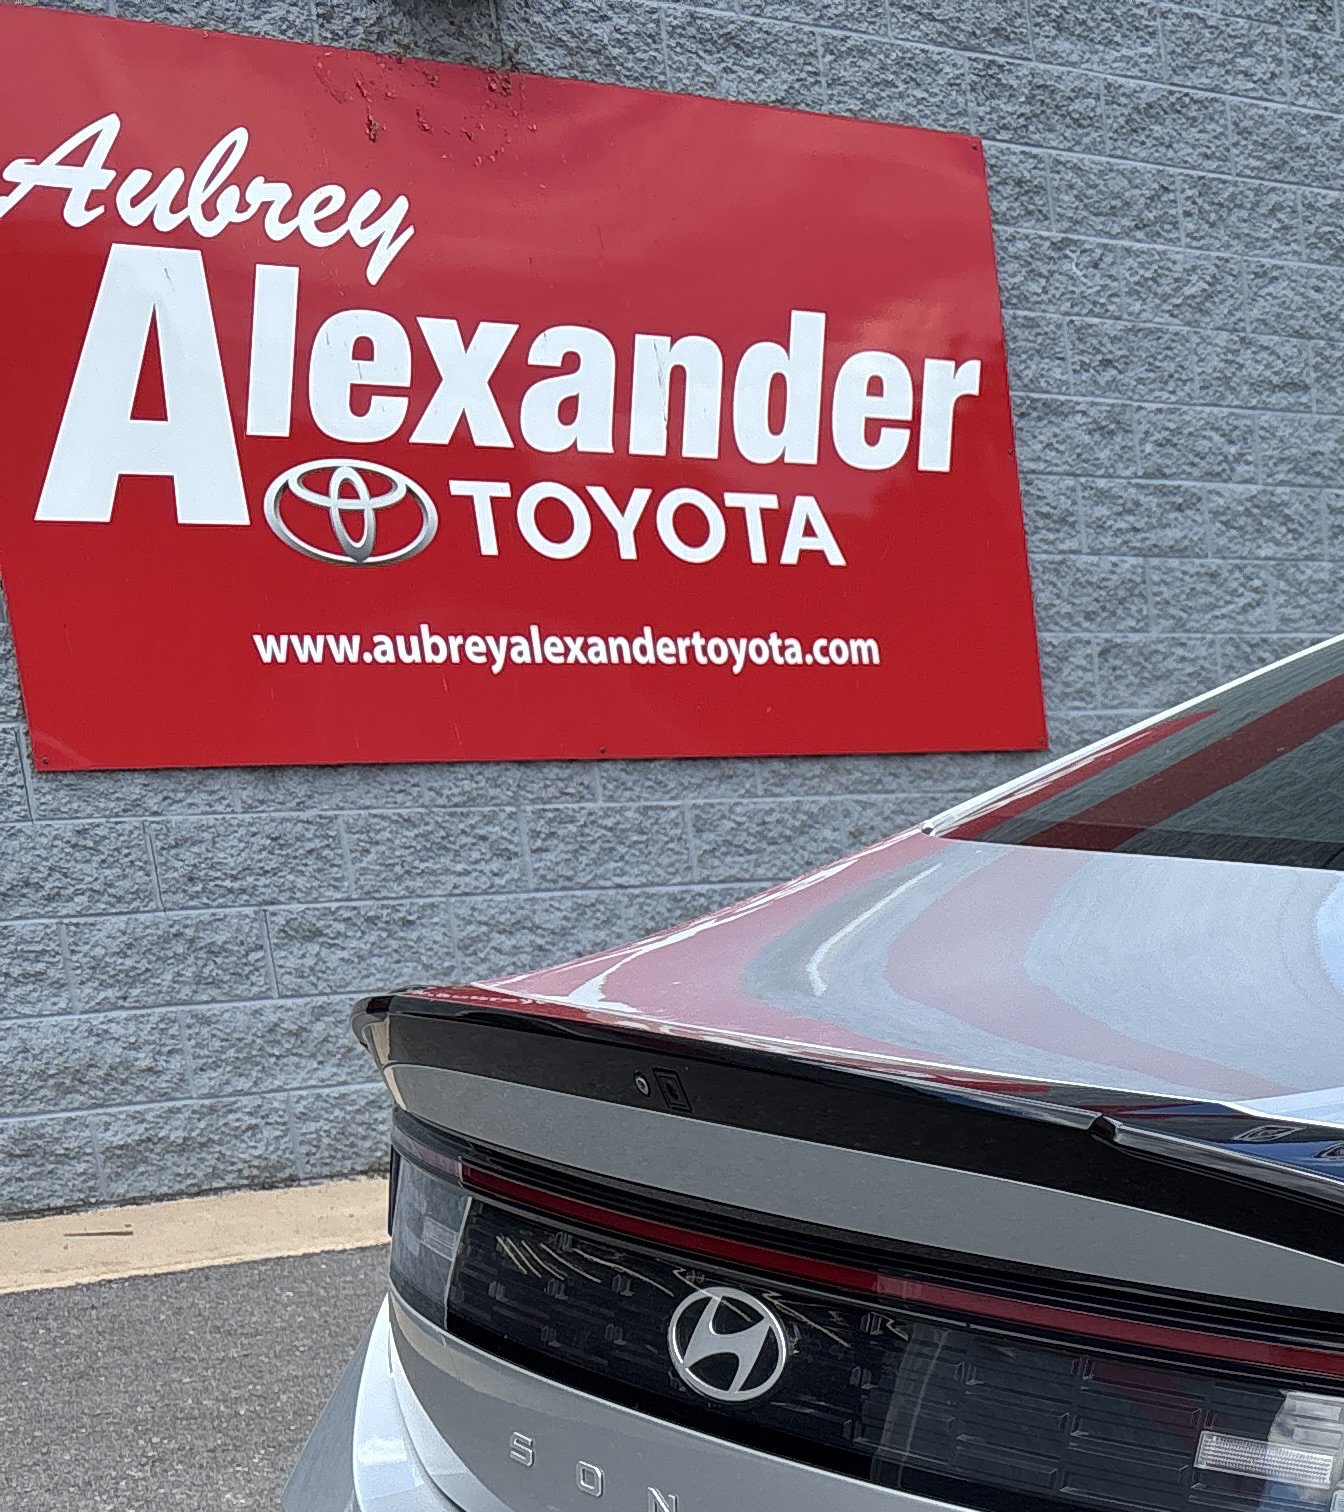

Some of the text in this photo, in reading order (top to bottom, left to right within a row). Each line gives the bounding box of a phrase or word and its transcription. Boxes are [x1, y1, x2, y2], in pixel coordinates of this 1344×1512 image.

[0, 112, 415, 286] Aubrey
[33, 241, 982, 527] Alexander
[449, 479, 848, 568] TOYOTA
[252, 624, 881, 675] www.aubreyalexandertoyota.com
